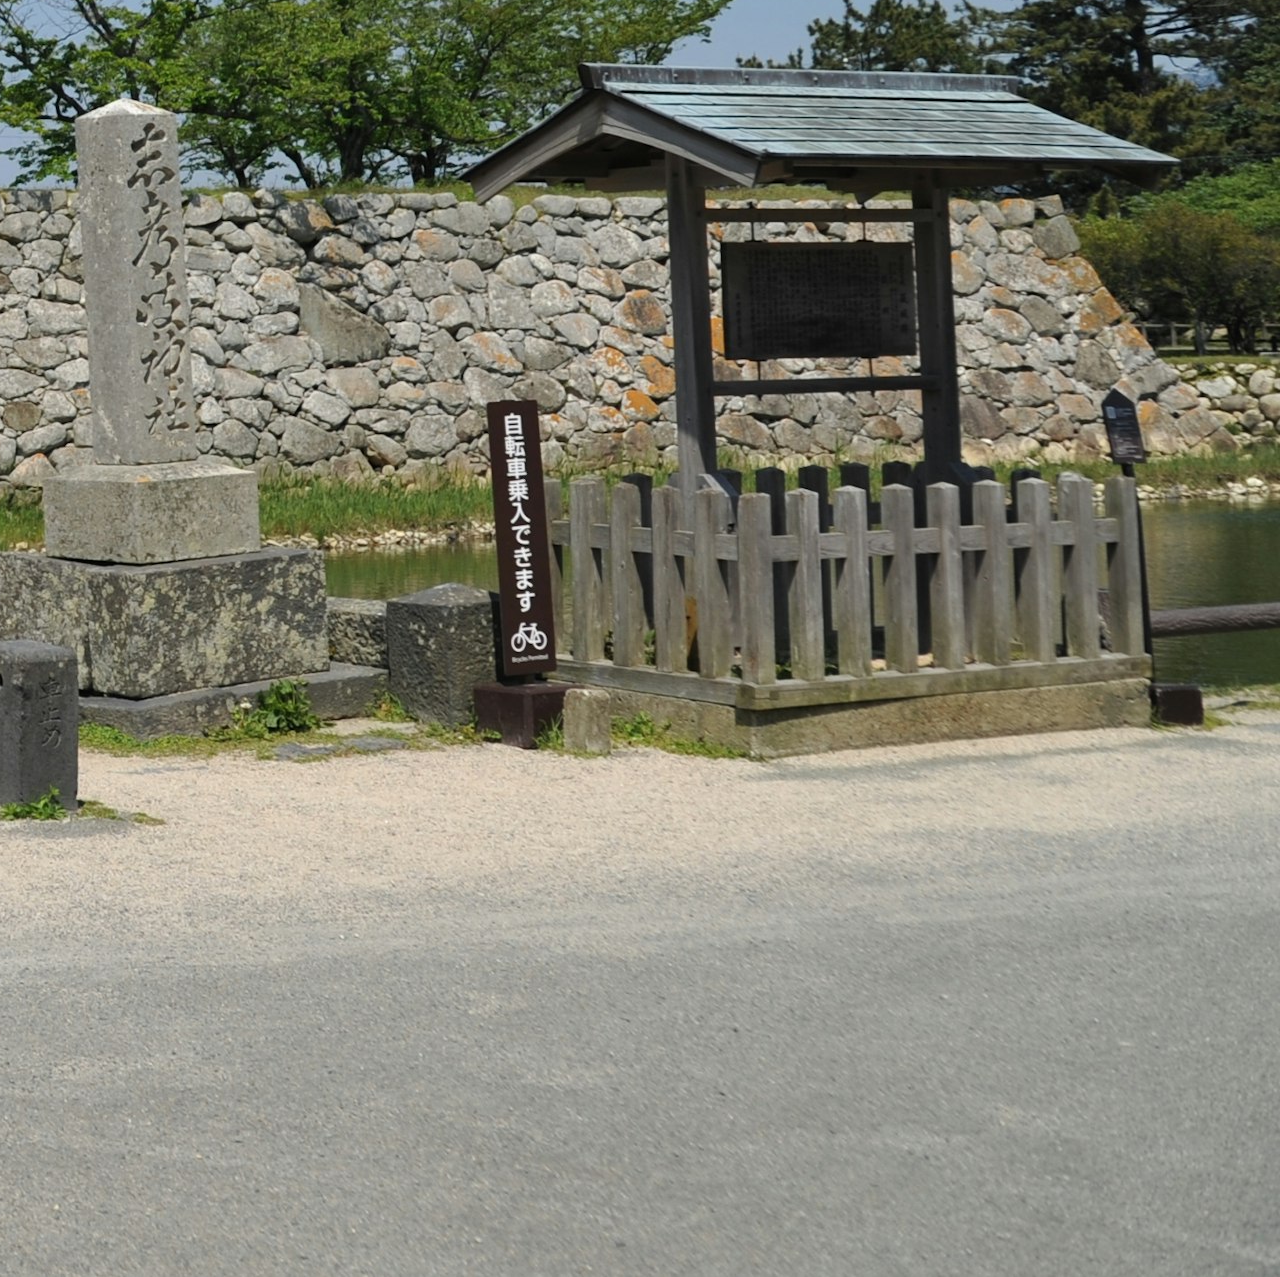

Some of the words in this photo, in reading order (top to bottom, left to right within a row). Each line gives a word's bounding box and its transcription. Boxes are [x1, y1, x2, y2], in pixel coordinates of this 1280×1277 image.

[504, 413, 535, 612] 自転車乗入できます
